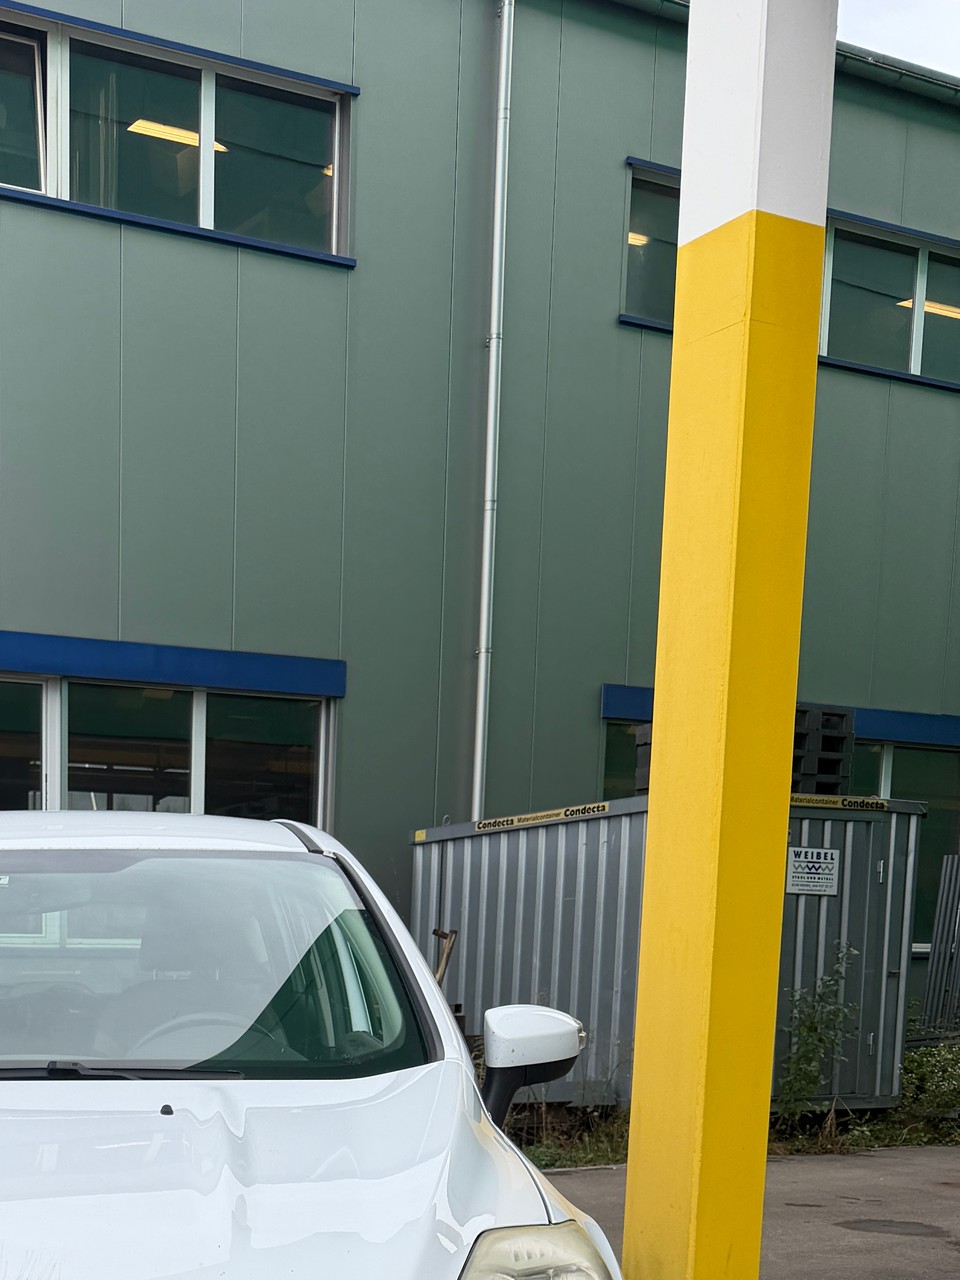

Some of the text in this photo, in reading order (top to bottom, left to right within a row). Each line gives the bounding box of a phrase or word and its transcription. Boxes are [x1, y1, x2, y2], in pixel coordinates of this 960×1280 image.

[841, 798, 885, 809] Condecta
[477, 818, 514, 830] Condecta
[564, 803, 606, 817] Condecta
[793, 850, 835, 861] WEIBEL
